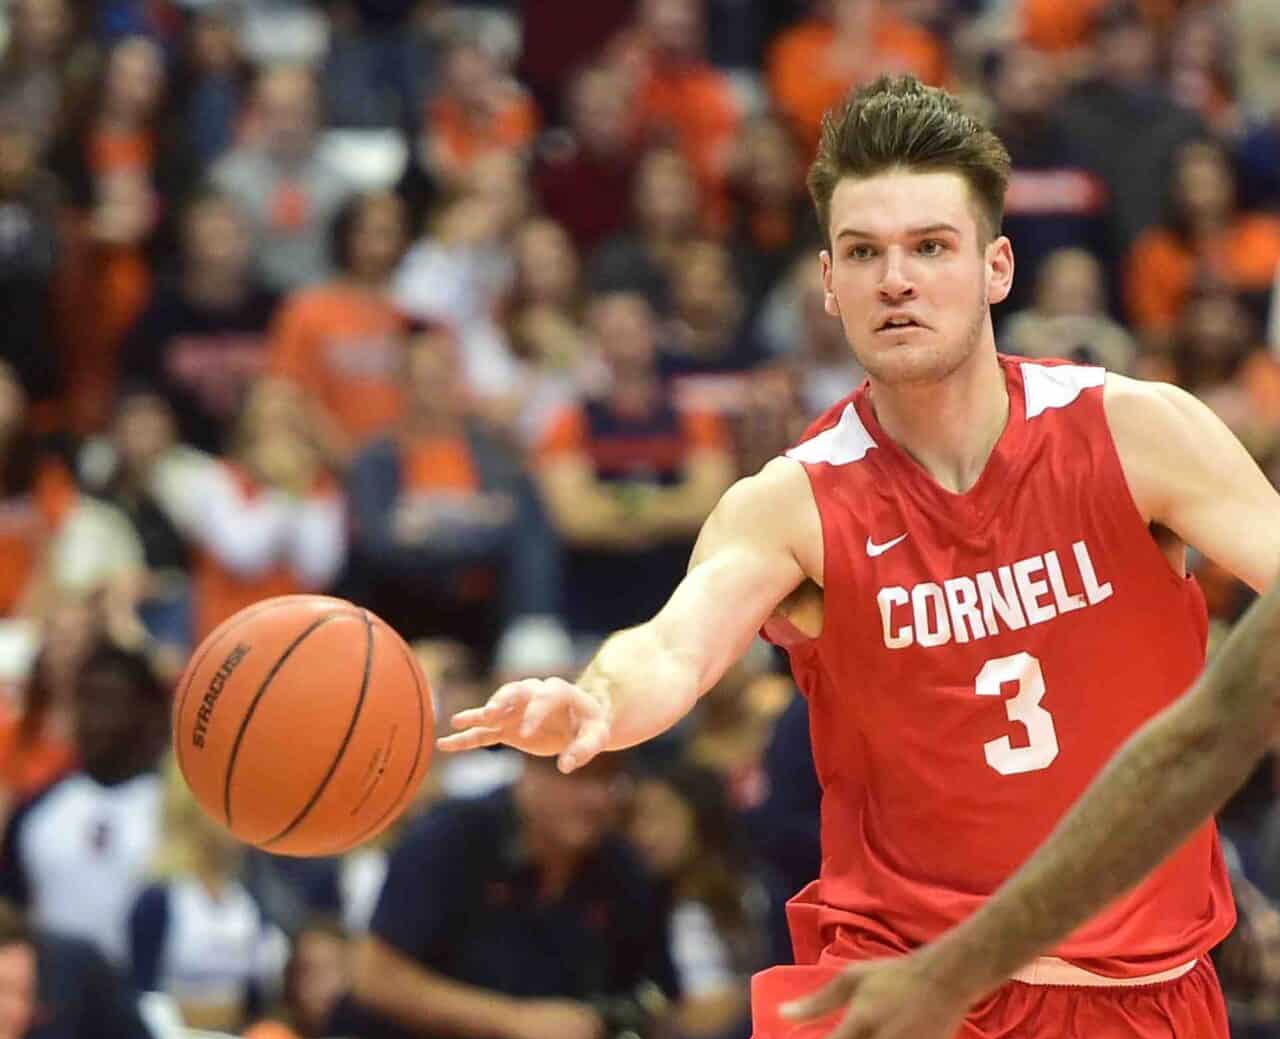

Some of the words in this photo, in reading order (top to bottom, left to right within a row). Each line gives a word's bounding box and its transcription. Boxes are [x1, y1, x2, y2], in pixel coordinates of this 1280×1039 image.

[876, 540, 1114, 650] CORNELL
[191, 643, 252, 751] SYRACUSE
[975, 651, 1060, 776] 3
